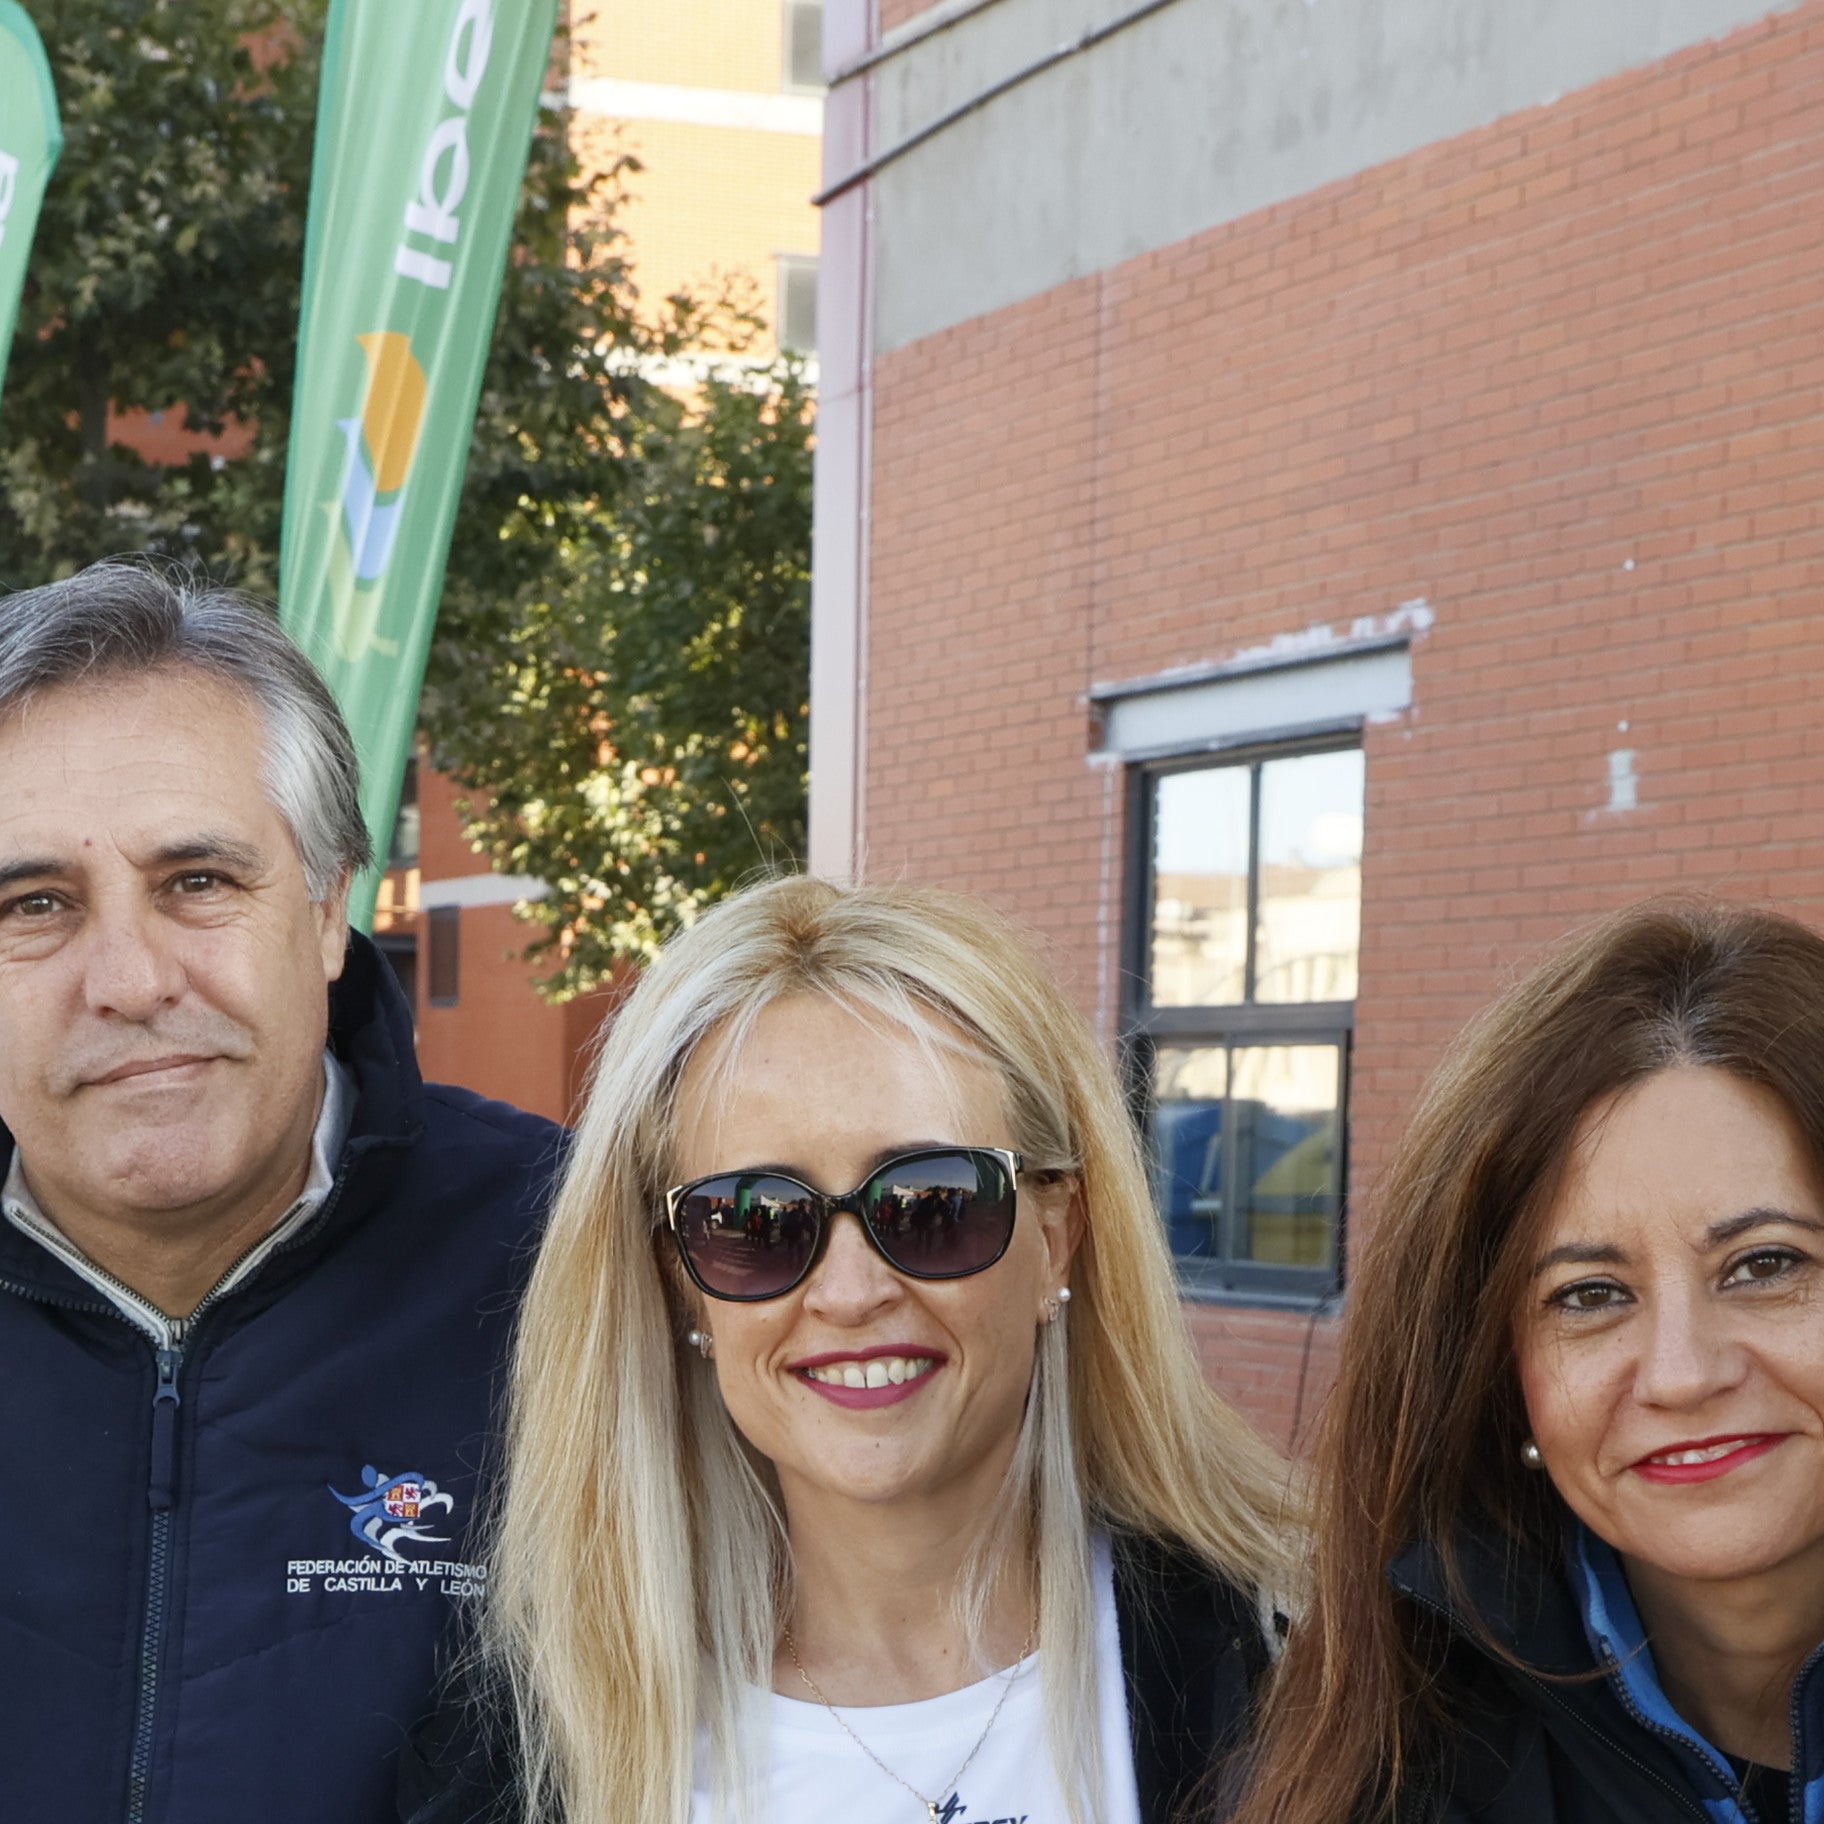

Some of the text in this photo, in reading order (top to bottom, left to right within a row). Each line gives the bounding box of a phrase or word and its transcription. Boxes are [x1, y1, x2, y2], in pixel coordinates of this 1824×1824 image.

[286, 1555, 488, 1581] FEDERACIÓN DE ATLETISMO
[286, 1576, 486, 1597] DE CASTILLA Y LEÓN
